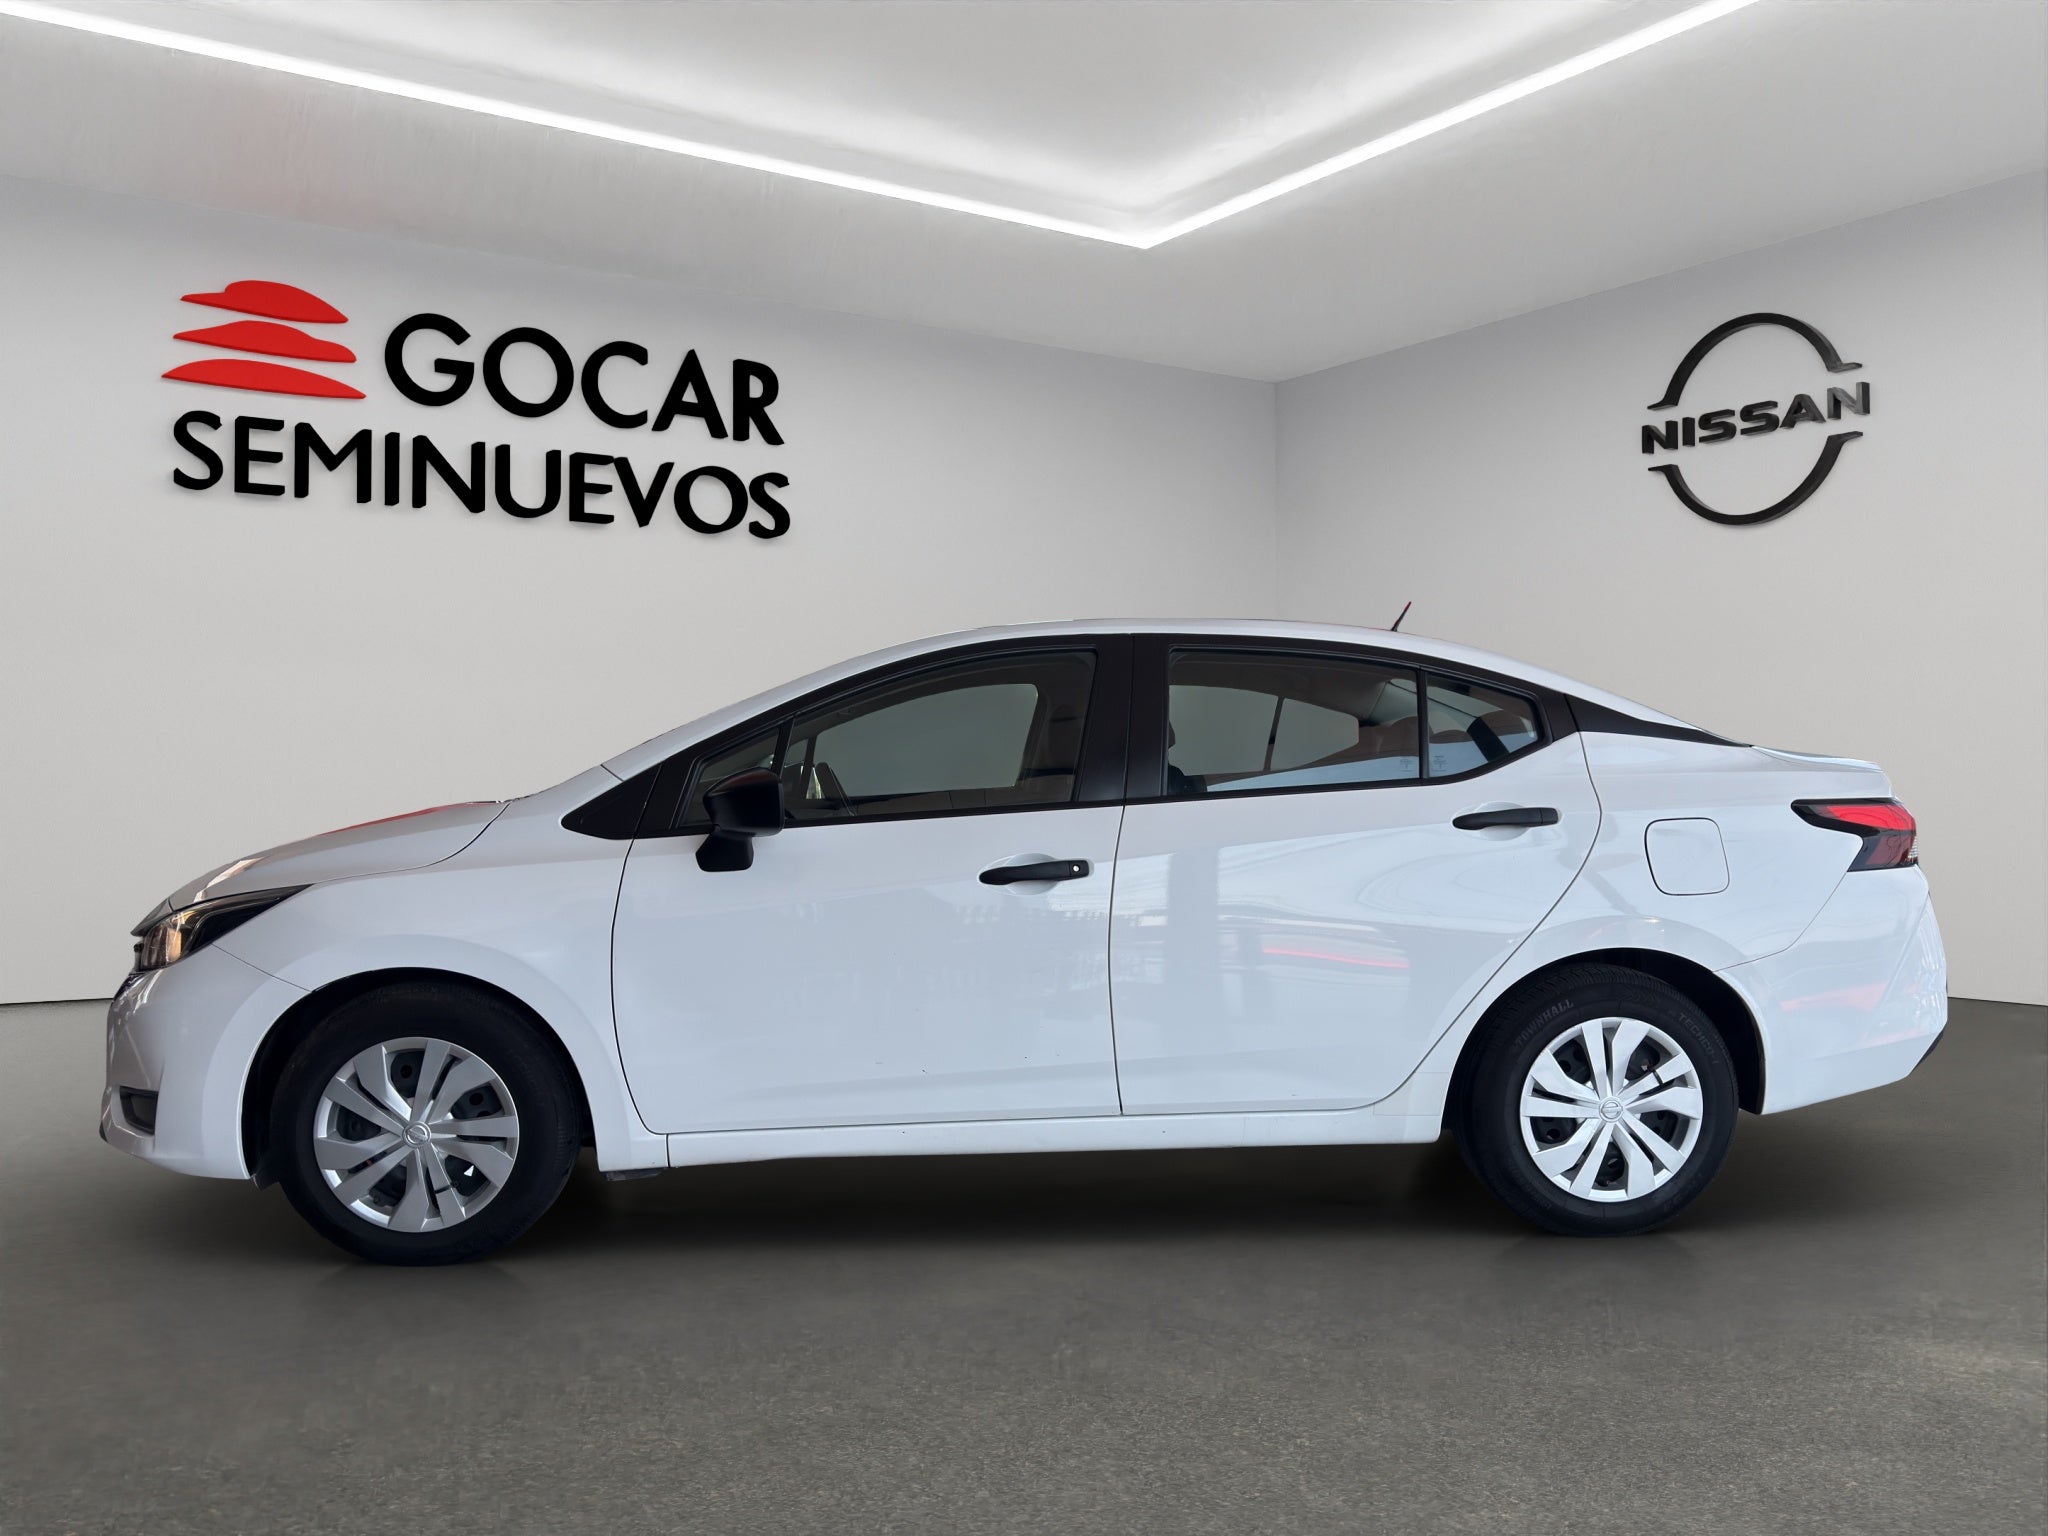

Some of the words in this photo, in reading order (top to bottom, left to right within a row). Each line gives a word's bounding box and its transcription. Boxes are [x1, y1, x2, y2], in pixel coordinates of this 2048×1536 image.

[384, 312, 786, 446] GOCAR
[1641, 381, 1871, 455] NISSAN
[173, 410, 792, 541] SEMINUEVOS
[1514, 999, 1574, 1048] TOWNHALL
